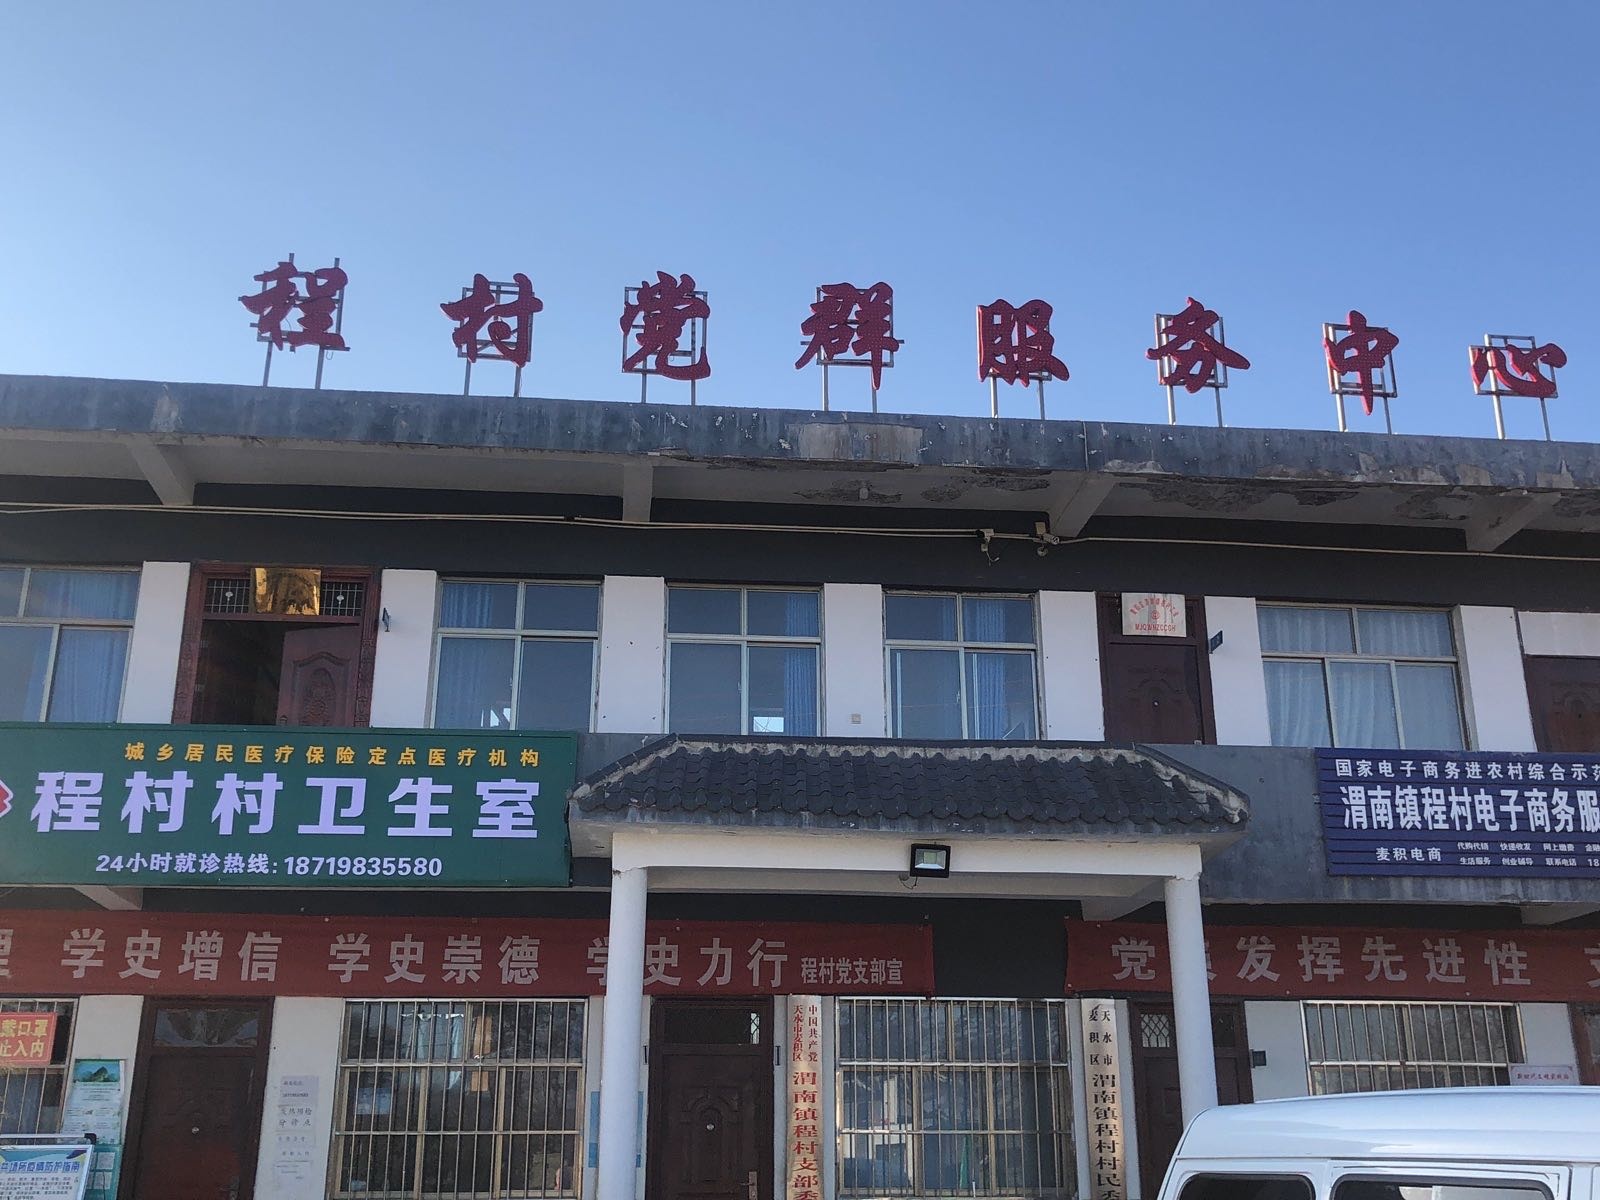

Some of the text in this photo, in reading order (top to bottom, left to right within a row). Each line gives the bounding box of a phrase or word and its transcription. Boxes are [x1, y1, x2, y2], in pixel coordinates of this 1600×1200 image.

[239, 262, 1567, 416] 程村党群服务中心
[125, 742, 539, 767] 城乡居民医疗保险定点医疗机构
[30, 770, 540, 838] 程村村卫生室
[1340, 785, 1600, 833] 渭南镇程村电子商务服
[1376, 847, 1442, 862] 麦积电商
[61, 928, 283, 982] 学史增信
[328, 932, 541, 985] 学史崇德
[800, 957, 904, 987] 程村党支部宣
[1112, 936, 1531, 986] 党发挥先进性
[808, 1004, 818, 1062] 中国共产党
[1089, 1009, 1100, 1066] 麦积区
[1101, 1010, 1112, 1067] 天水市
